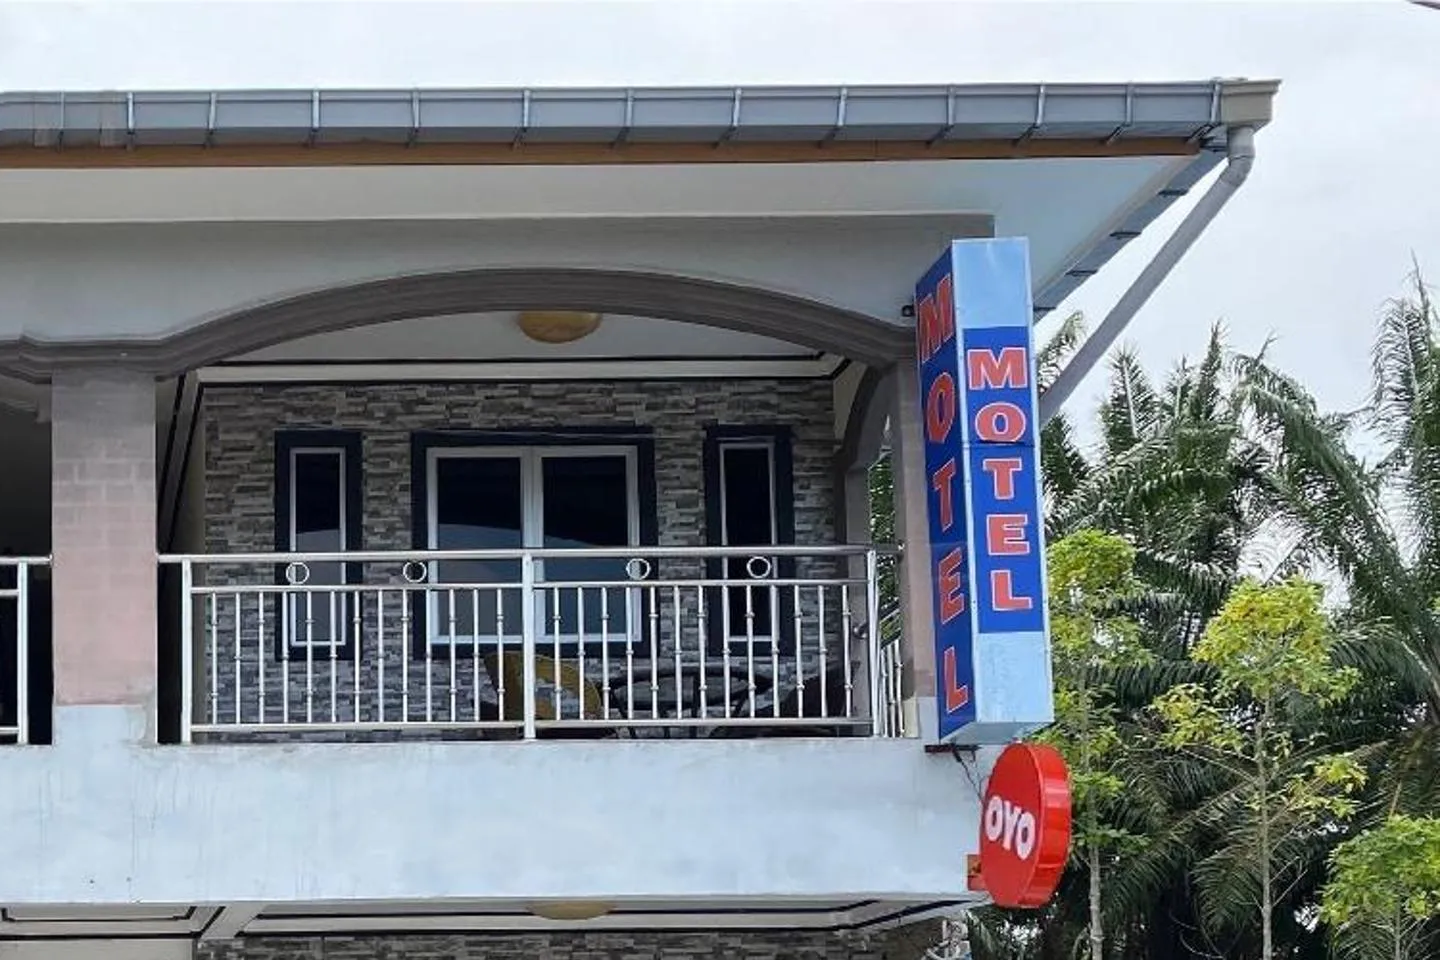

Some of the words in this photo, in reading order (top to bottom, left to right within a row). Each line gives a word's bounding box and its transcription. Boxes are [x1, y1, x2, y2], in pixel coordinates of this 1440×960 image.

[919, 273, 969, 713] MOTEL
[969, 348, 1033, 612] MOTEL
[986, 795, 1035, 860] OYO
